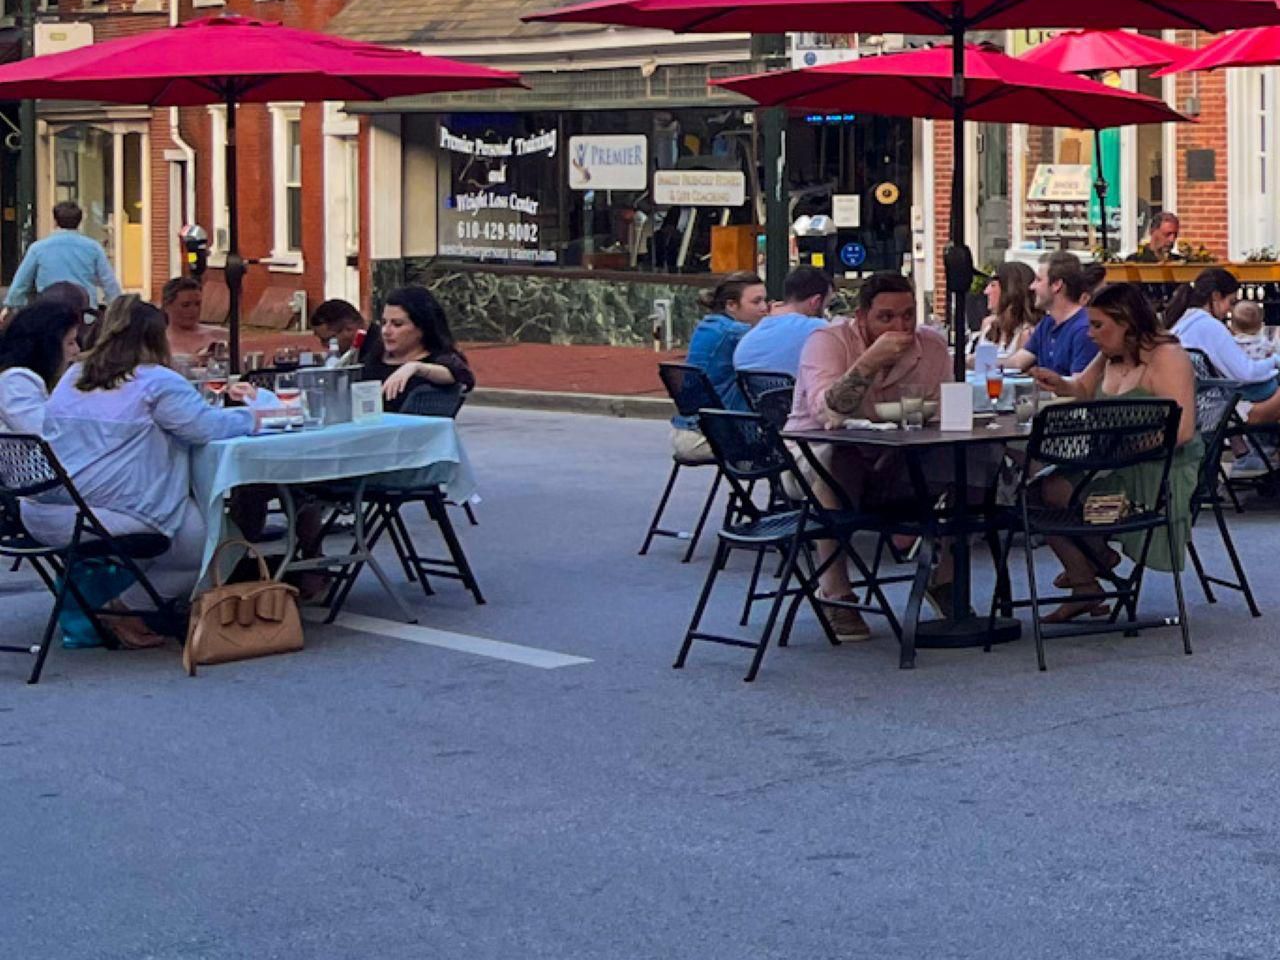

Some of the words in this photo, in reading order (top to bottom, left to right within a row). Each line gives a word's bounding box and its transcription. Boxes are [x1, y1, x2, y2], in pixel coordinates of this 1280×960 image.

[591, 144, 643, 166] PREMIER
[456, 189, 488, 216] Weight
[488, 192, 509, 209] Loss
[509, 192, 539, 216] Center
[457, 220, 539, 242] 610-429-9002
